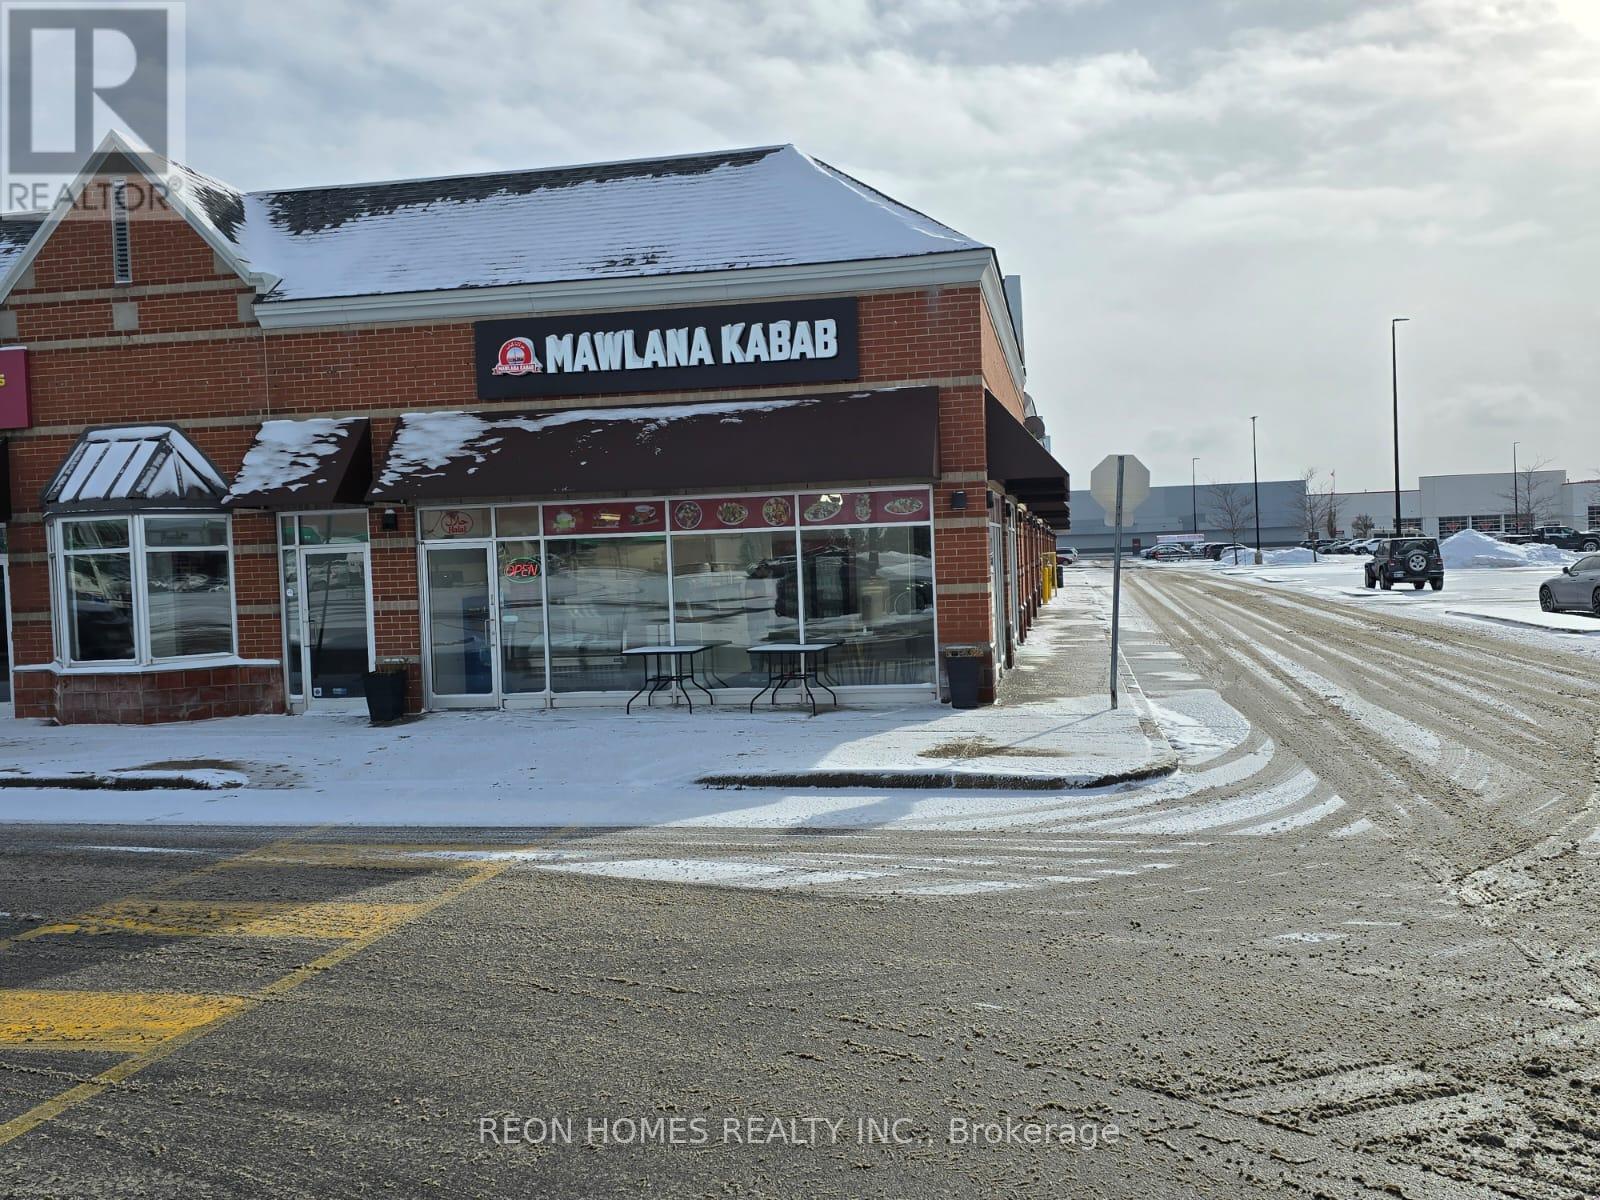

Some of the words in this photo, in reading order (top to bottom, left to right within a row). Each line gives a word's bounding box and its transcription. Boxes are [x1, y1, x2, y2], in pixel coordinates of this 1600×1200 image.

[545, 326, 715, 374] MAWLANA
[721, 318, 838, 364] KABAB
[505, 563, 538, 577] OPEN
